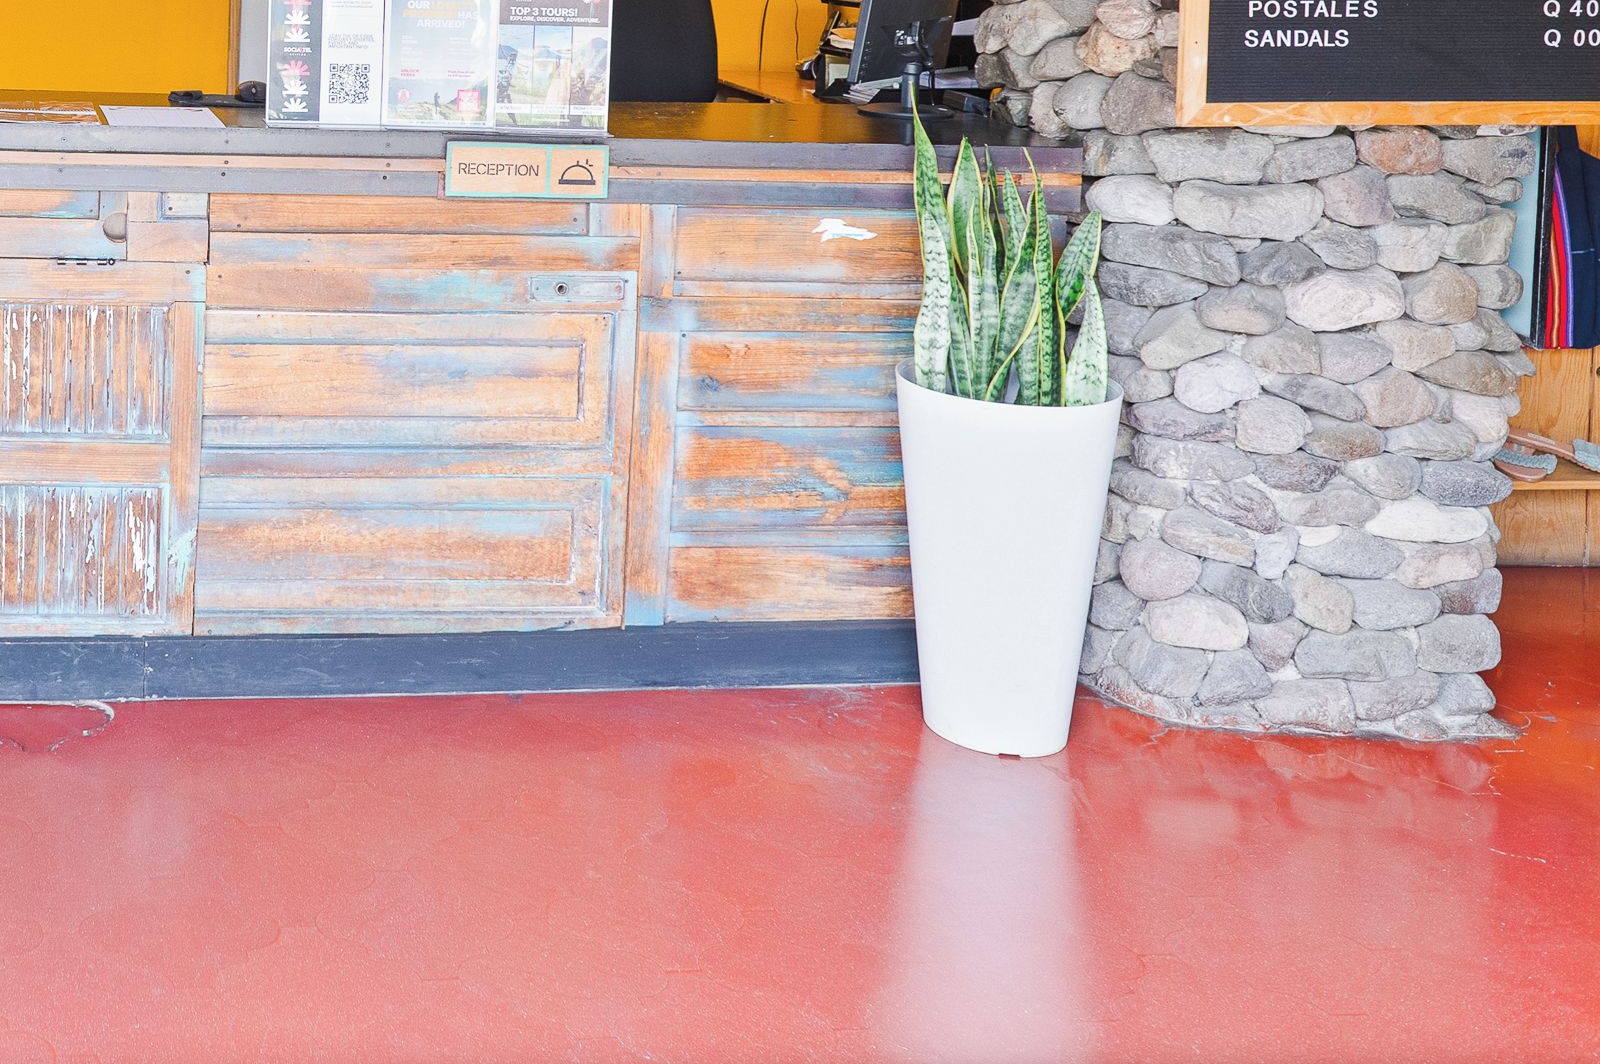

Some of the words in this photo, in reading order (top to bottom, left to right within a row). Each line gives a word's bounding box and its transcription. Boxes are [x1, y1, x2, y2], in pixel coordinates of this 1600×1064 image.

[407, 0, 431, 9] OUR
[510, 6, 531, 16] TOP
[532, 7, 539, 16] 3
[540, 7, 578, 17] TOURS!
[1248, 0, 1379, 18] POSTALES
[1569, 0, 1600, 17] 40
[1244, 29, 1350, 48] SANDALS
[457, 162, 540, 177] RECEPTION
